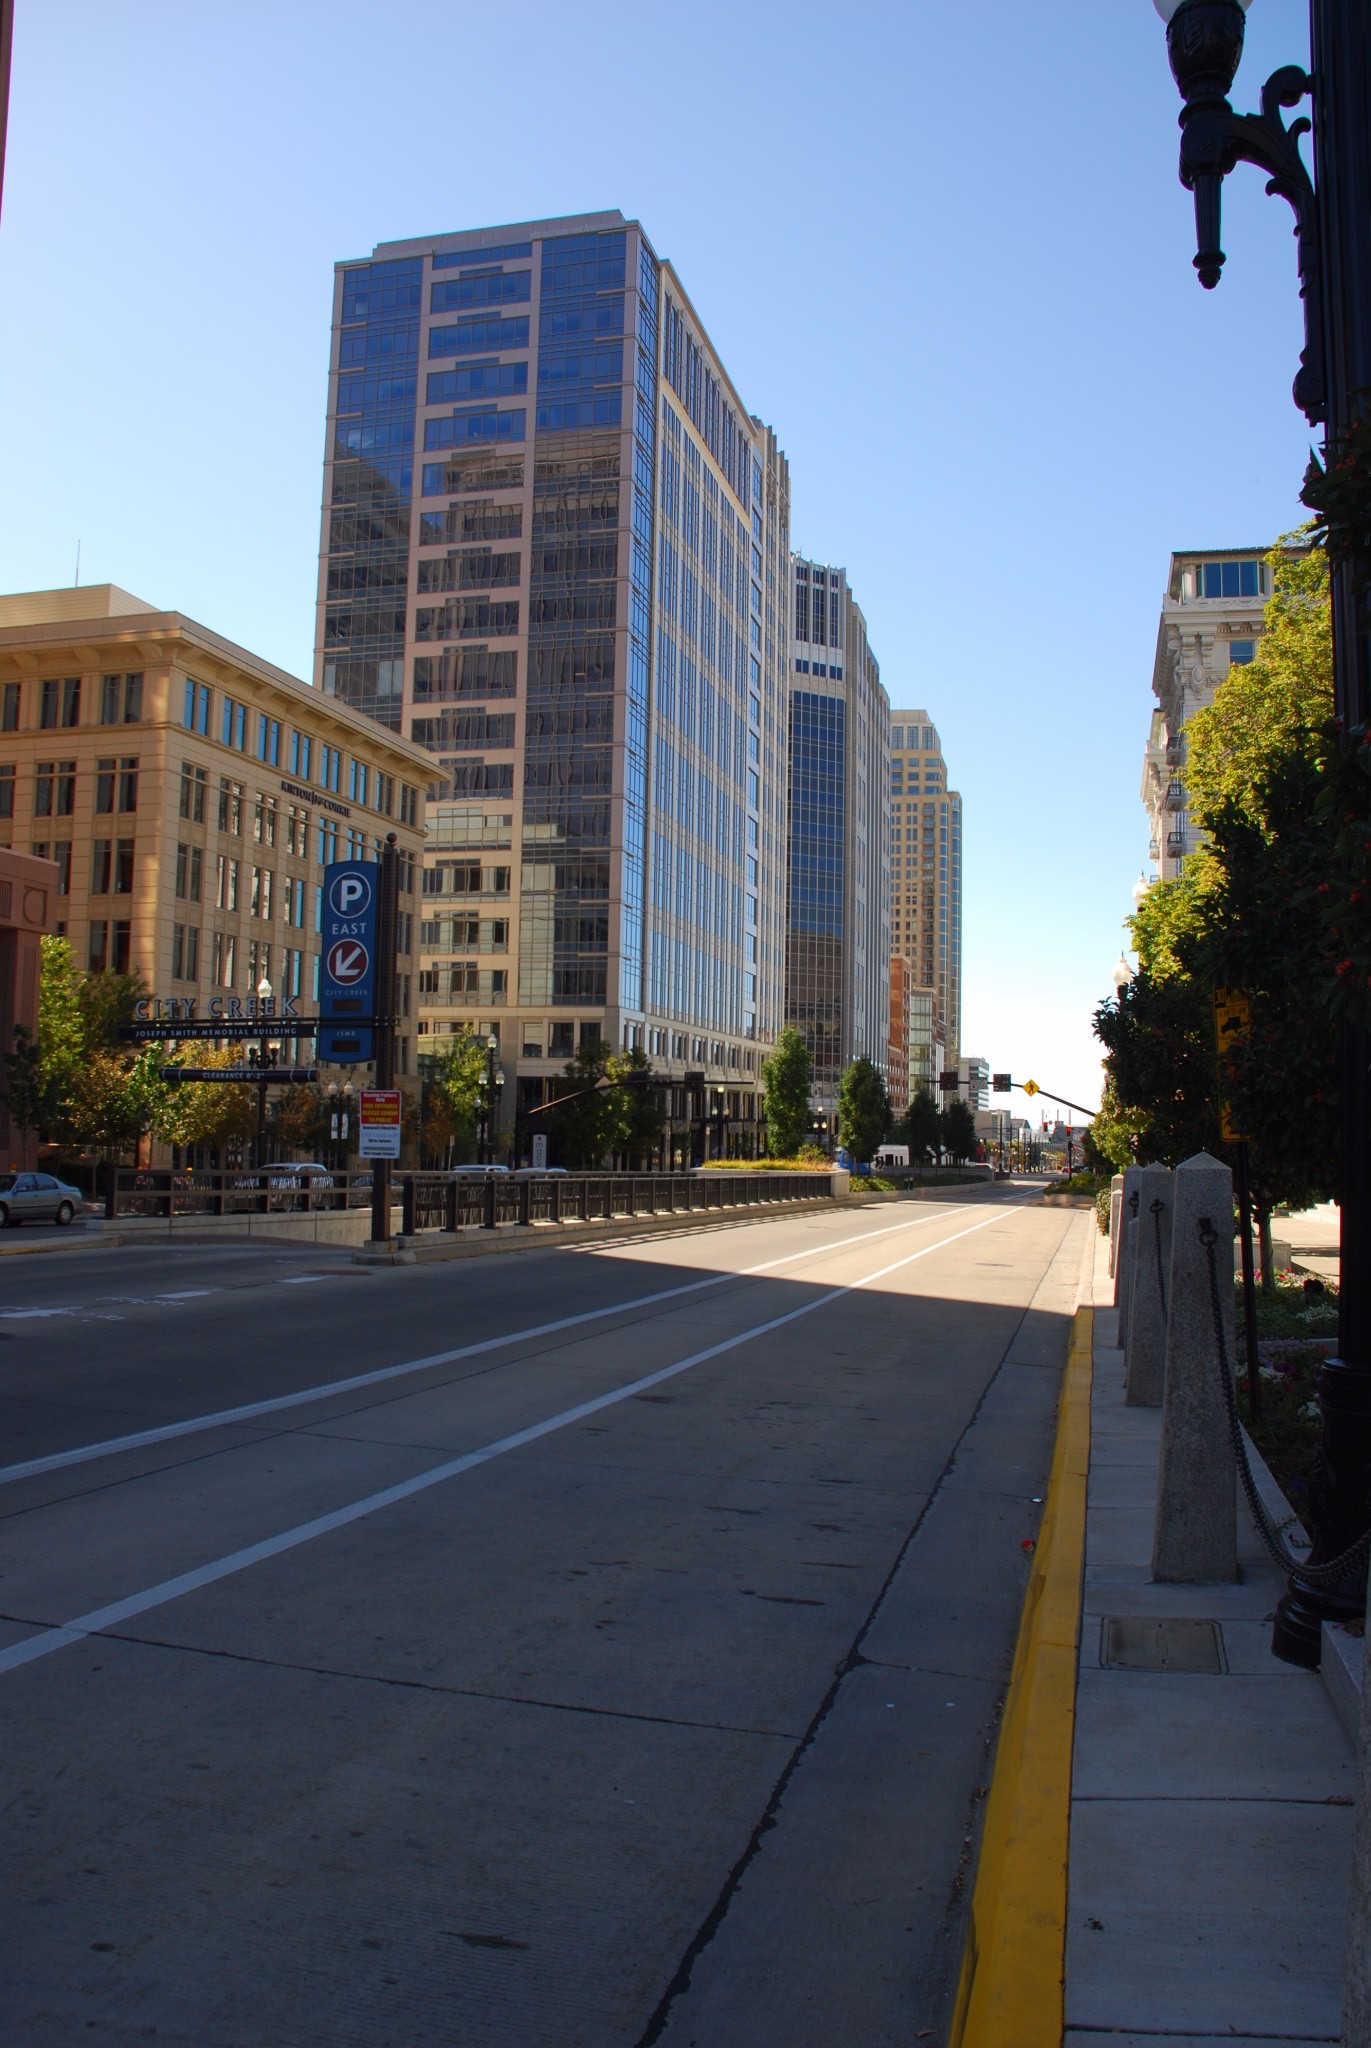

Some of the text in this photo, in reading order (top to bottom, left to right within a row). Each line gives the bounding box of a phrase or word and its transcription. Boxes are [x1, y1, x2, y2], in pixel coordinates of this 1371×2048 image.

[340, 879, 363, 911] P
[332, 923, 368, 935] EAST
[135, 995, 299, 1019] CITY CREEK
[135, 1027, 297, 1038] JOSEPH SMITH MEMORIAL BUILDING
[202, 1072, 244, 1080] CLEARANCE
[535, 1142, 544, 1168] macy
